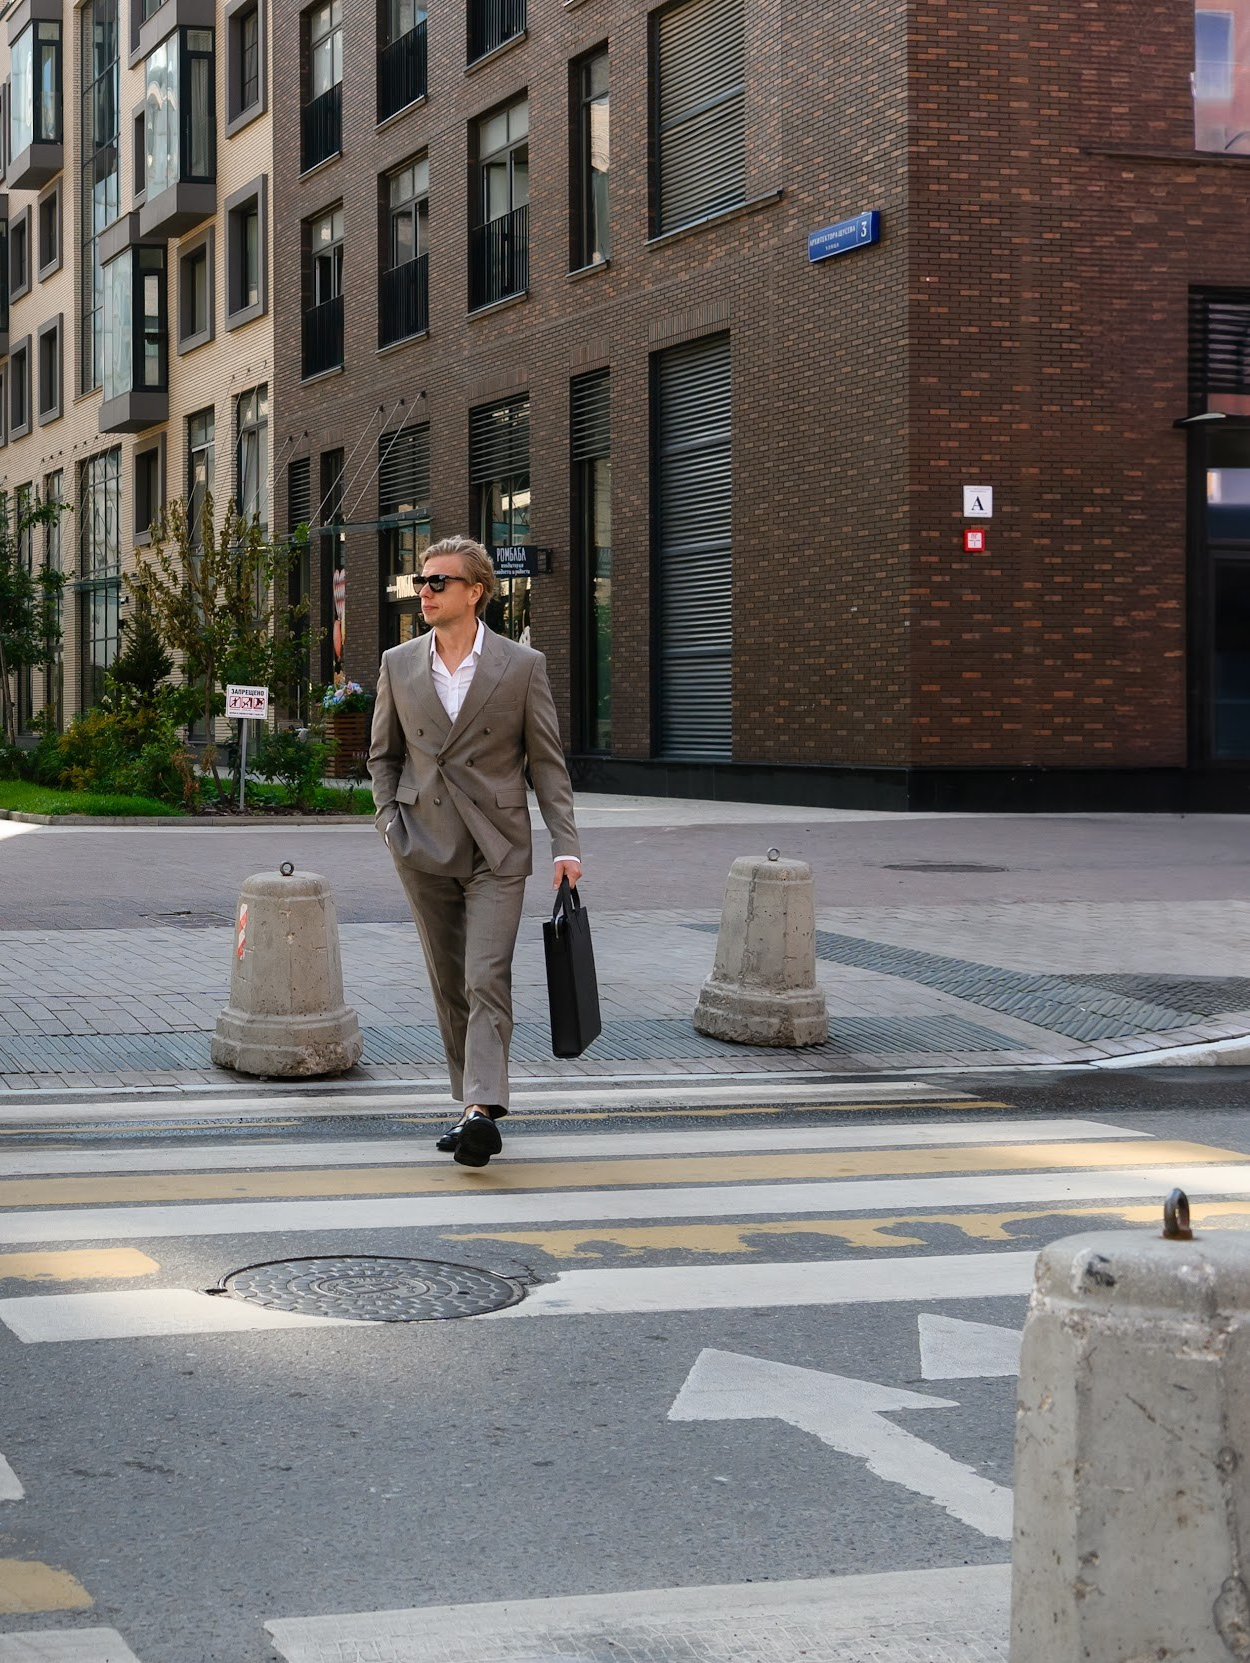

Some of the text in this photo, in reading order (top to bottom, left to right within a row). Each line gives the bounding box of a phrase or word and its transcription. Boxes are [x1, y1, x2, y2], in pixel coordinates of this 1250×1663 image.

[860, 221, 867, 237] 3
[496, 546, 527, 562] РОМБАБА
[231, 688, 265, 697] ЗАПРЕЩЕНО
